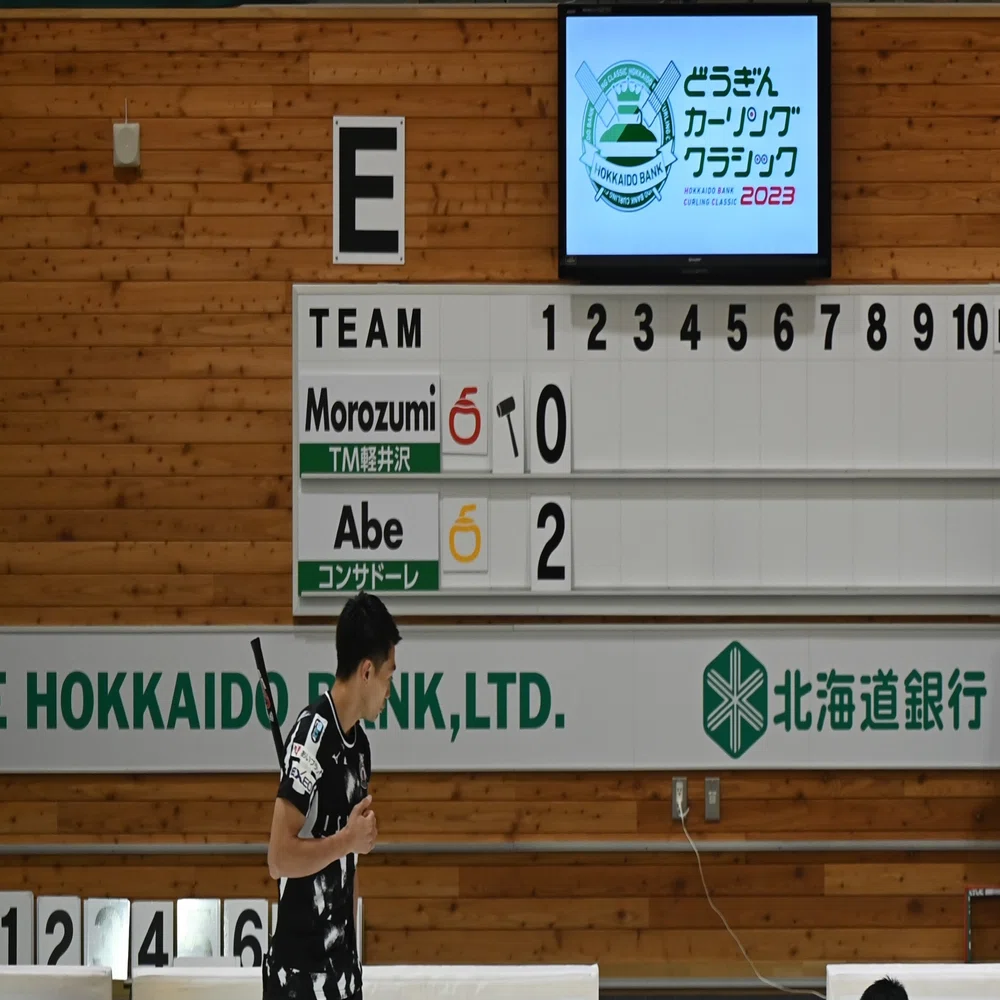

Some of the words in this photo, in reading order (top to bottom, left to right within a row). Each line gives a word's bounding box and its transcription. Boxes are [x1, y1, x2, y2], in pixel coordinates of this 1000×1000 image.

[684, 66, 778, 97] どうぎん
[684, 106, 800, 137] カーリング
[594, 163, 638, 187] HOKKAIDO
[639, 162, 664, 184] BANK
[684, 147, 798, 178] クラシック
[339, 127, 399, 253] E
[683, 198, 710, 206] CURLING
[711, 198, 738, 206] CLASSIC
[684, 187, 716, 195] HOKKAIDO
[740, 186, 796, 205] 2023
[309, 308, 422, 348] TEAM
[542, 304, 555, 350] 1
[587, 303, 607, 350] 2
[634, 303, 654, 351] 3
[680, 304, 701, 350] 4
[727, 303, 748, 351] 5
[773, 303, 794, 351] 6
[820, 304, 840, 350] 7
[867, 303, 887, 351] 8
[913, 303, 934, 351] 9
[952, 303, 988, 351] 10
[305, 383, 436, 433] Morozumi
[536, 384, 566, 464] 0
[329, 446, 411, 473] TM軽井沢
[334, 501, 403, 550] Abe
[537, 502, 565, 580] 2
[318, 564, 419, 590] コンサドーレ
[26, 671, 289, 730] HOKKAIDO
[773, 668, 987, 732] 北海道銀行
[138, 911, 169, 967] 4
[233, 909, 263, 967] 6
